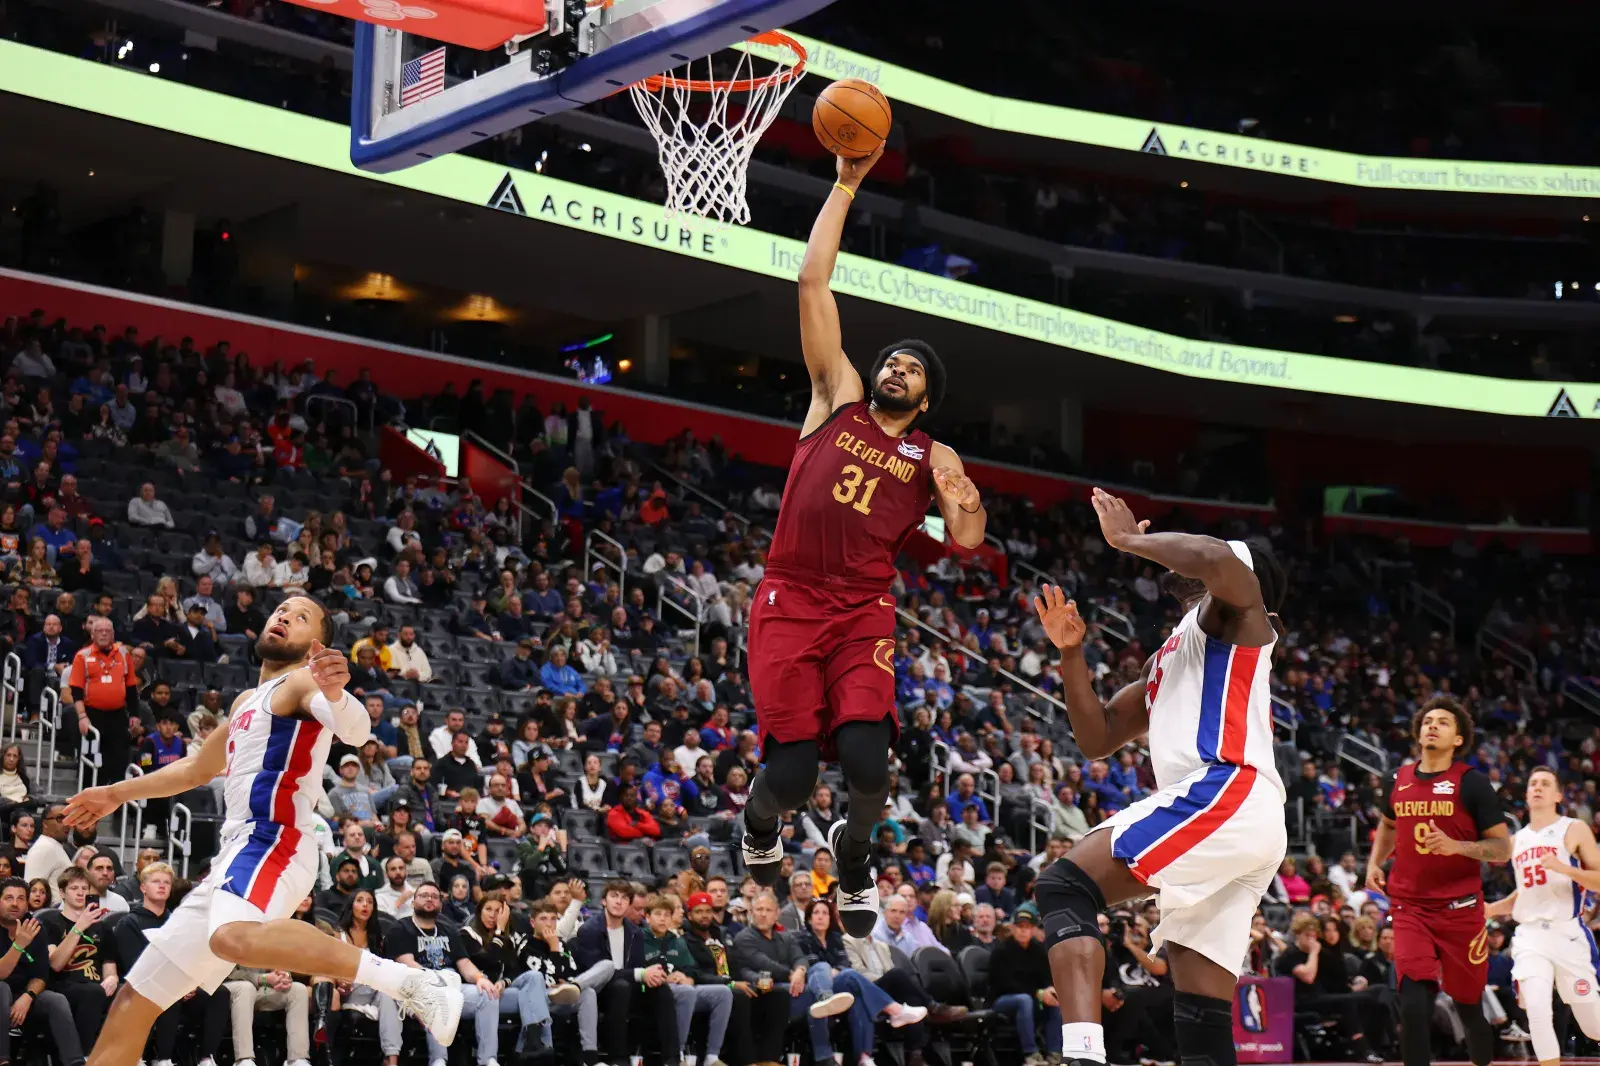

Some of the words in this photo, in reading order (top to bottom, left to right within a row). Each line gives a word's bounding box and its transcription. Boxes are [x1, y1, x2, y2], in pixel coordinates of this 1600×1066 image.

[1178, 139, 1309, 173] ACRISURE
[1355, 161, 1449, 187] Full-court
[1454, 166, 1538, 190] business
[540, 193, 715, 254] ACRISURE
[769, 241, 876, 293] Insnce,
[1015, 302, 1100, 346] Employee
[1179, 347, 1215, 370] and
[835, 431, 916, 484] CLEVELAND
[832, 464, 881, 516] 31
[1393, 800, 1455, 817] CLEVELAND
[1414, 822, 1432, 855] 9
[1523, 864, 1547, 888] 55
